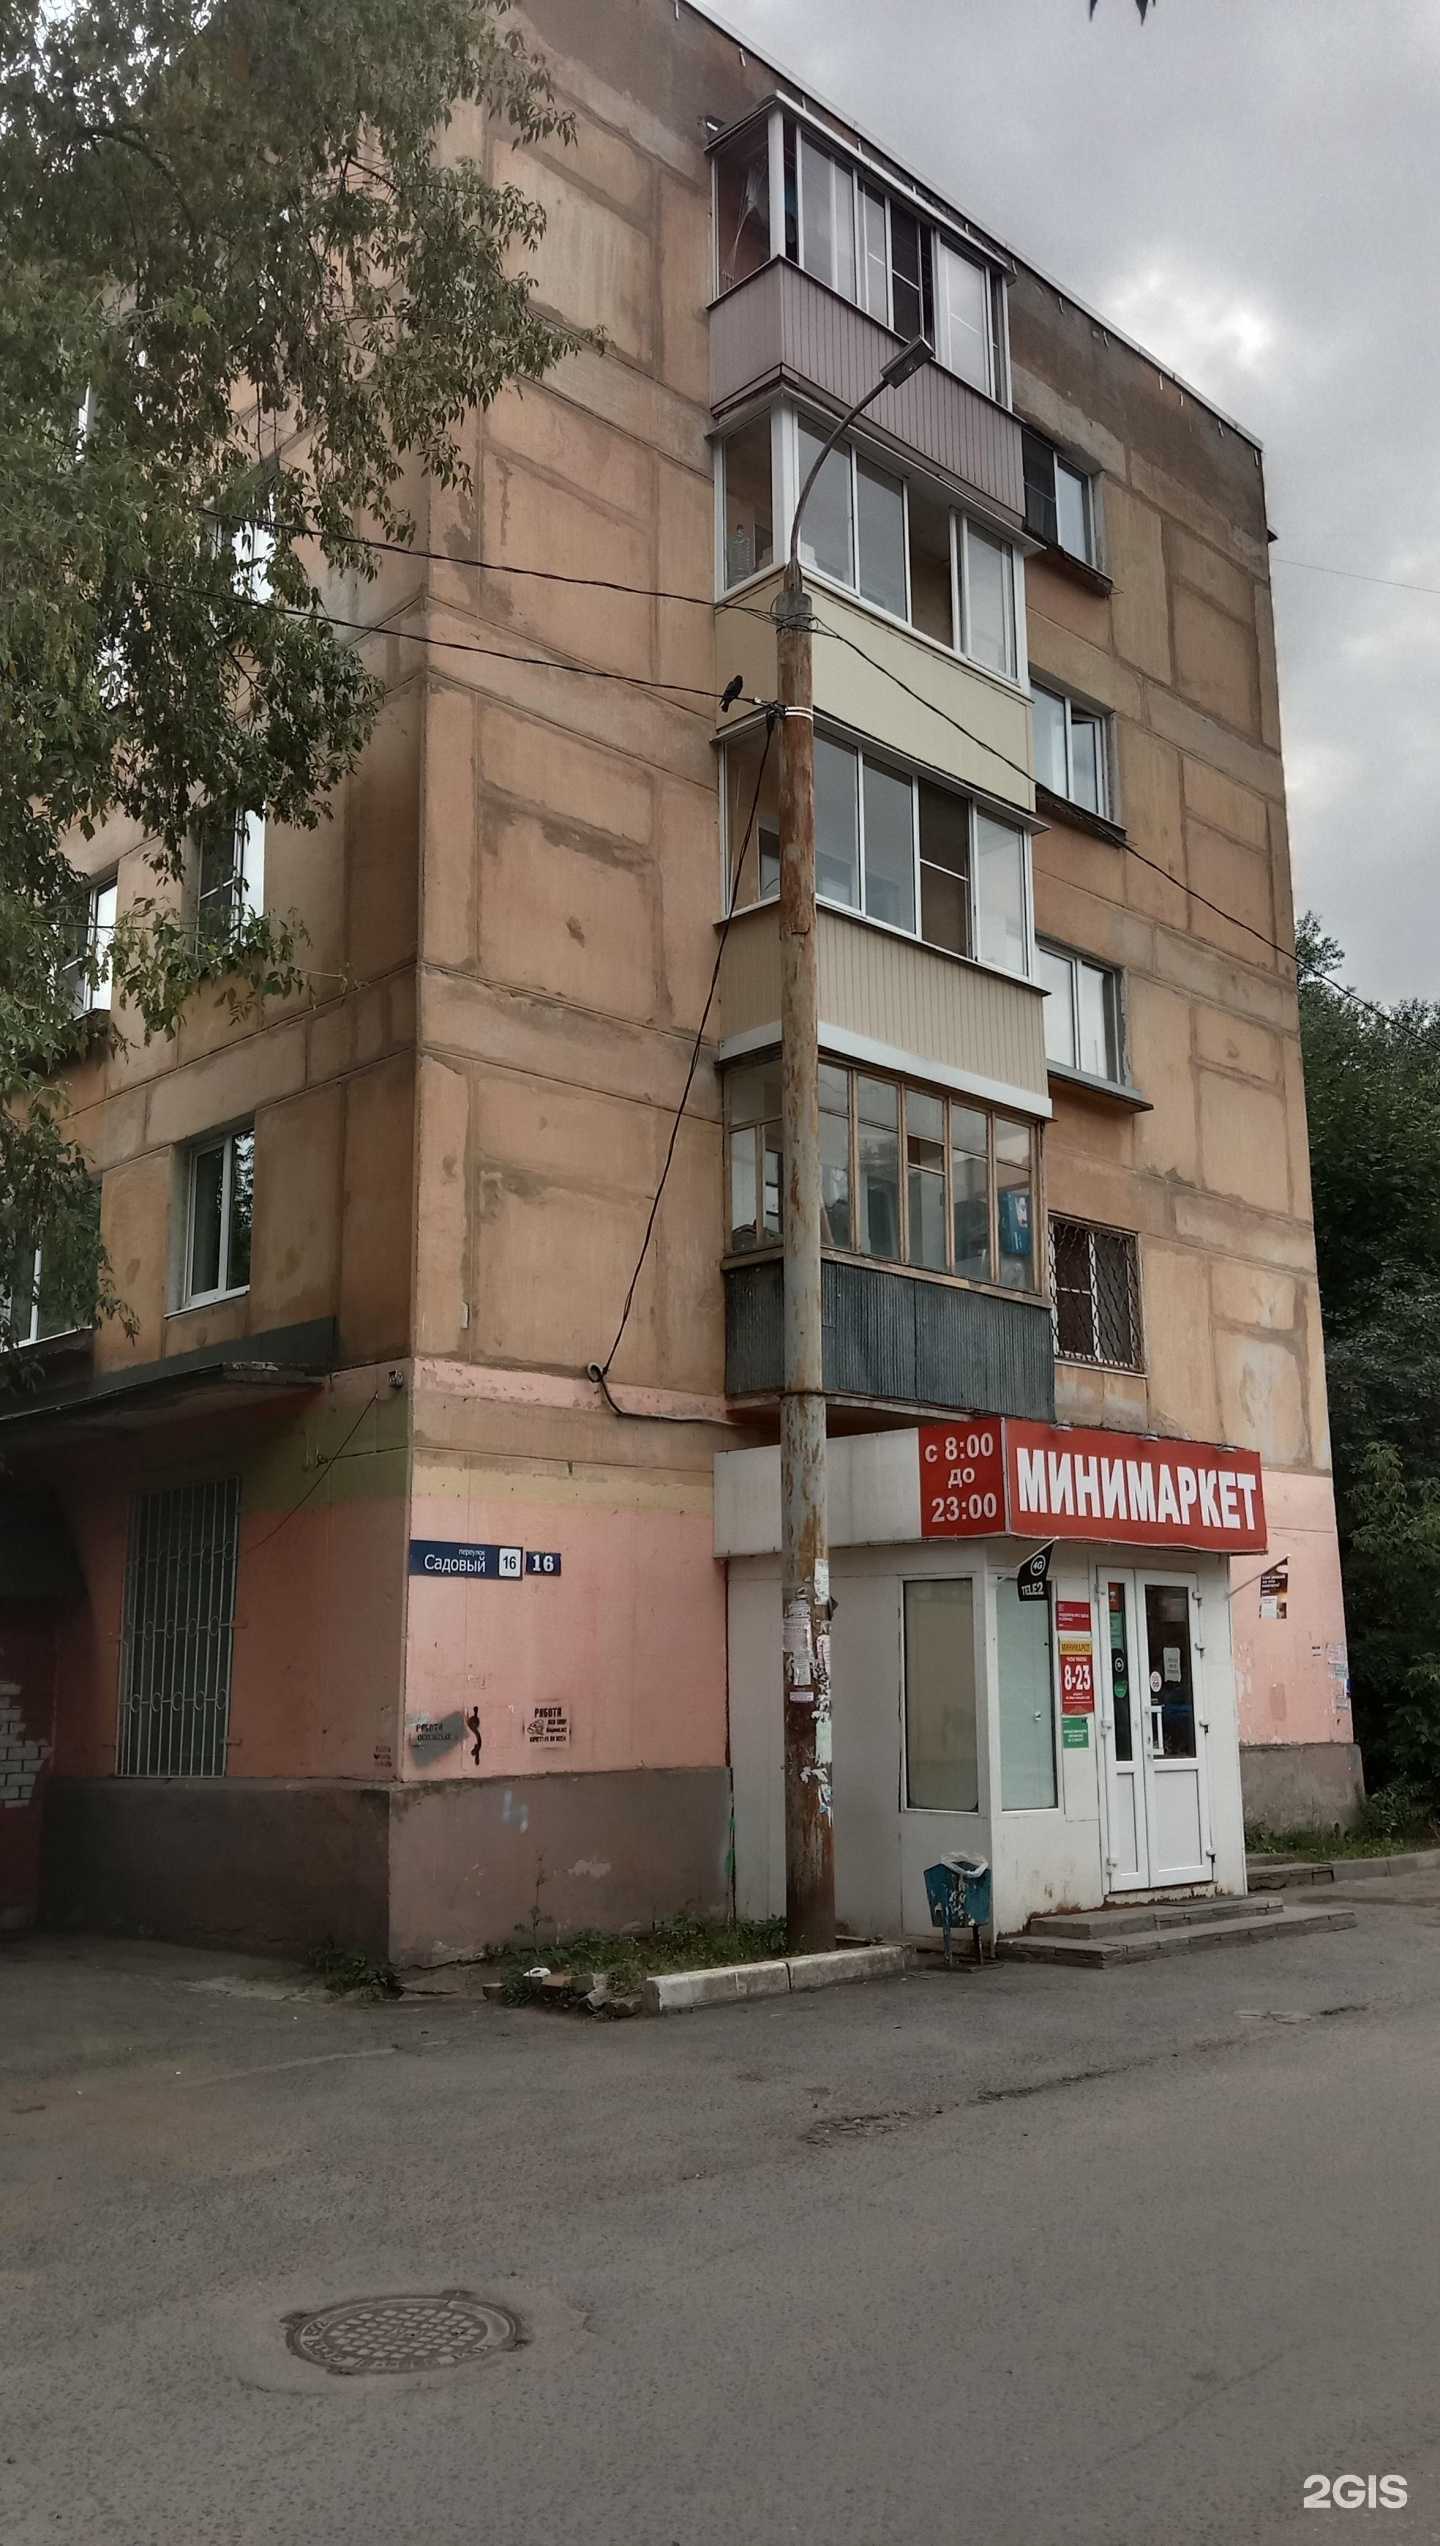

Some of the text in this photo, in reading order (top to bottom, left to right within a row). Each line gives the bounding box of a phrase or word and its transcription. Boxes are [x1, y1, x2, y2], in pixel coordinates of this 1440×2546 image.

[944, 1432, 994, 1461] 8:00
[948, 1467, 975, 1489] до
[1016, 1447, 1256, 1530] МИНИМАРКЕТ
[931, 1493, 997, 1523] 23:00
[424, 1554, 486, 1574] Садовый
[503, 1556, 517, 1570] 16
[532, 1555, 554, 1572] 16
[1033, 1560, 1044, 1570] 4G
[1021, 1581, 1044, 1595] TELE2
[1064, 1663, 1091, 1691] 8-23
